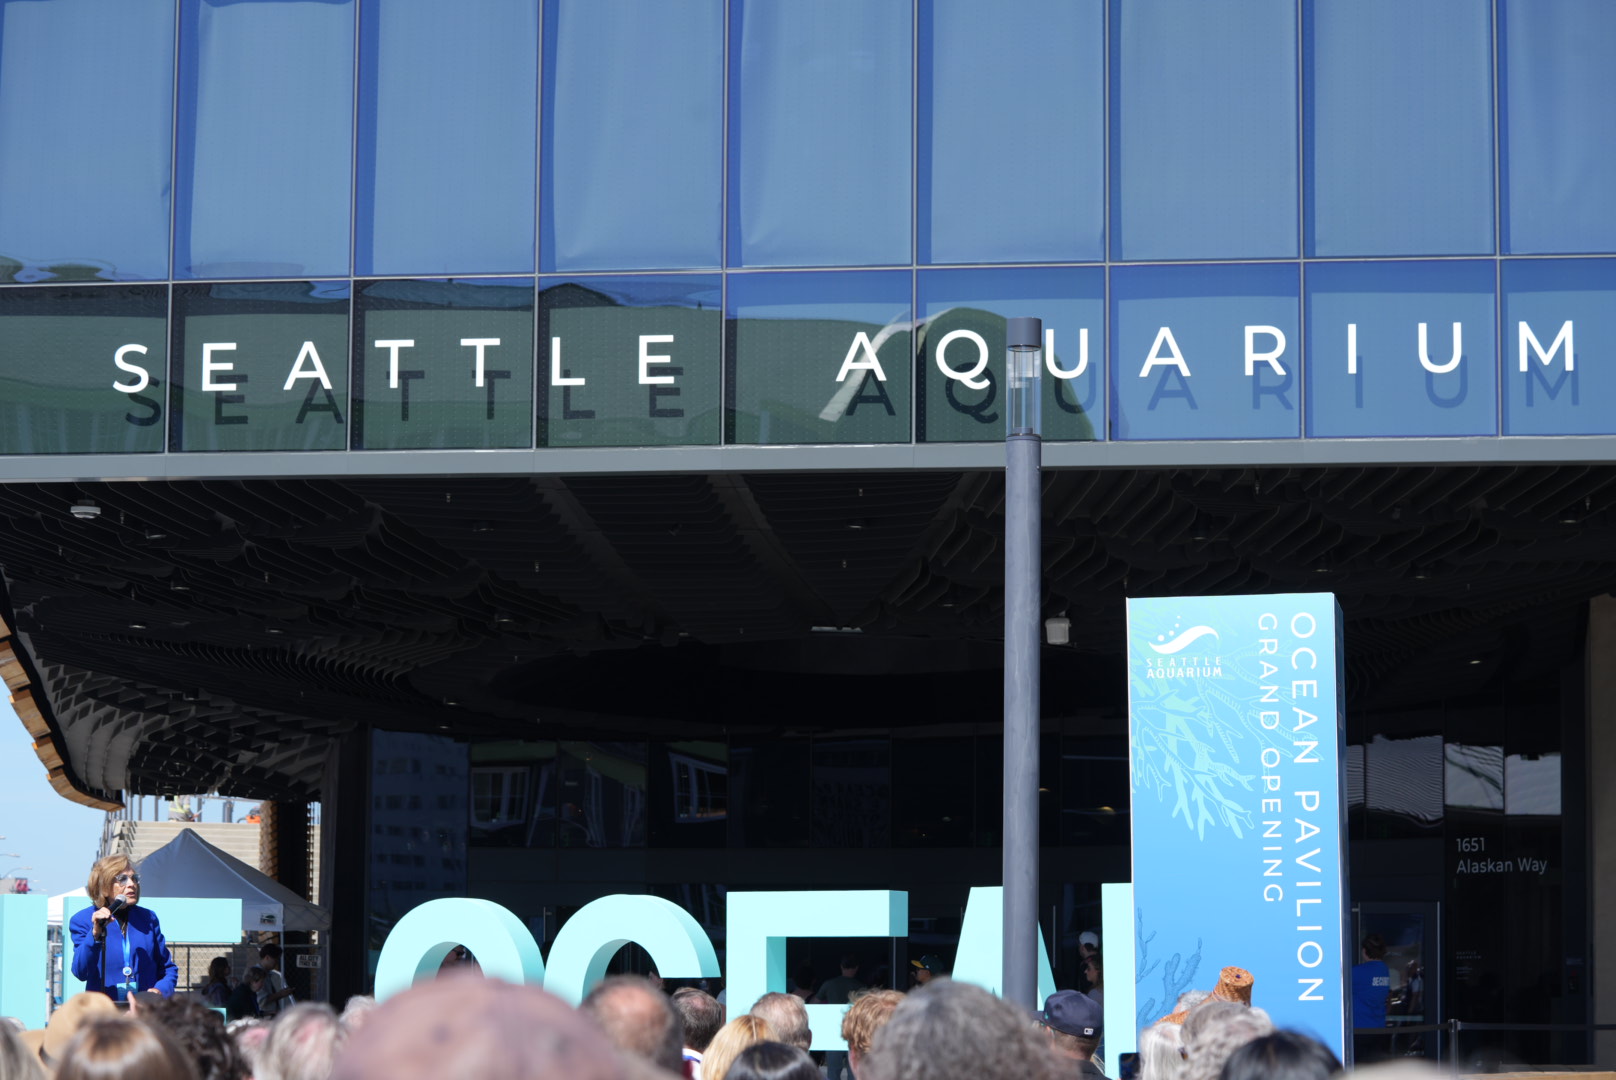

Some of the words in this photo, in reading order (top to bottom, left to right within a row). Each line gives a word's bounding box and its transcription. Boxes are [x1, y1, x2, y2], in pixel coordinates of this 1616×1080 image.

[112, 335, 675, 393] SEATTLE
[835, 320, 1575, 390] AQUARIUM
[1146, 656, 1222, 667] SEATTLE
[1146, 666, 1223, 679] AQUARIUM
[1258, 613, 1279, 730] GRAND
[1290, 612, 1319, 763] OCEAN
[1260, 749, 1283, 902] OPENING
[1456, 837, 1485, 852] 1651
[1294, 790, 1324, 1001] PAVILION
[1456, 857, 1513, 874] Alaskan
[1517, 857, 1548, 875] Way
